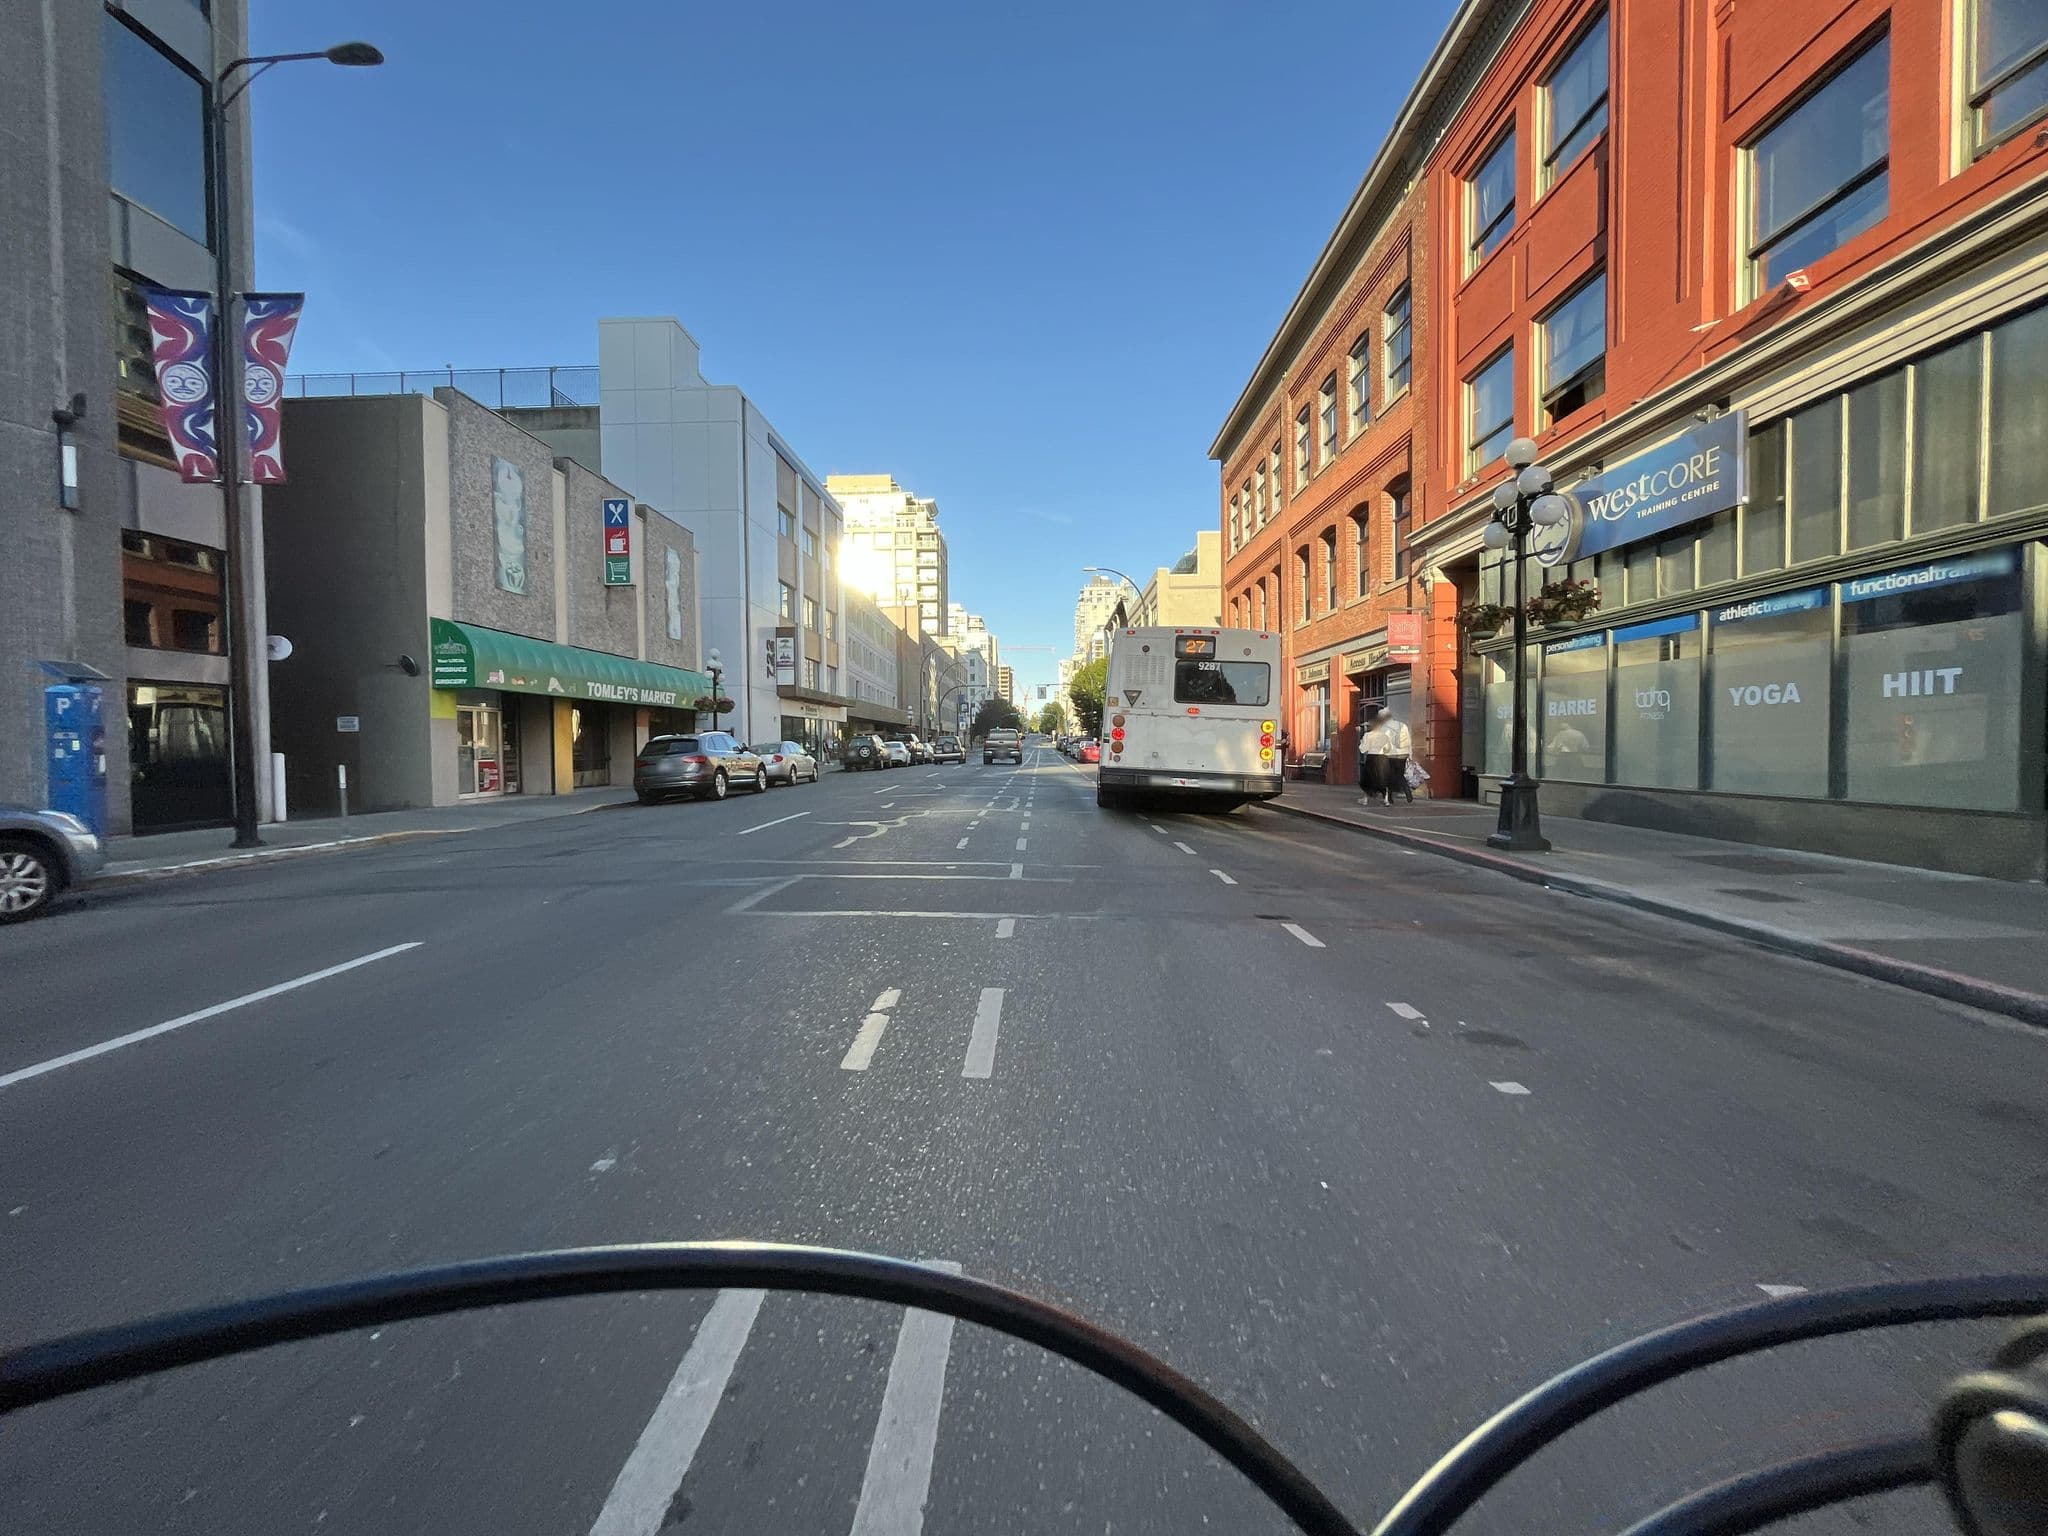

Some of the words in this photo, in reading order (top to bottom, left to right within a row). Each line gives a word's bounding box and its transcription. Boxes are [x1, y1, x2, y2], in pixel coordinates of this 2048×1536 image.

[1636, 498, 1678, 519] TRAINING
[1681, 481, 1720, 502] CENTRE
[1186, 639, 1206, 653] 27
[1198, 661, 1221, 672] 9287
[1349, 656, 1366, 669] Access
[1883, 667, 1963, 698] HIIT
[587, 681, 638, 701] TOMLEY'S
[641, 689, 677, 705] MARKET
[1728, 682, 1801, 706] YOGA
[56, 697, 71, 715] P
[1548, 698, 1598, 716] BARRE
